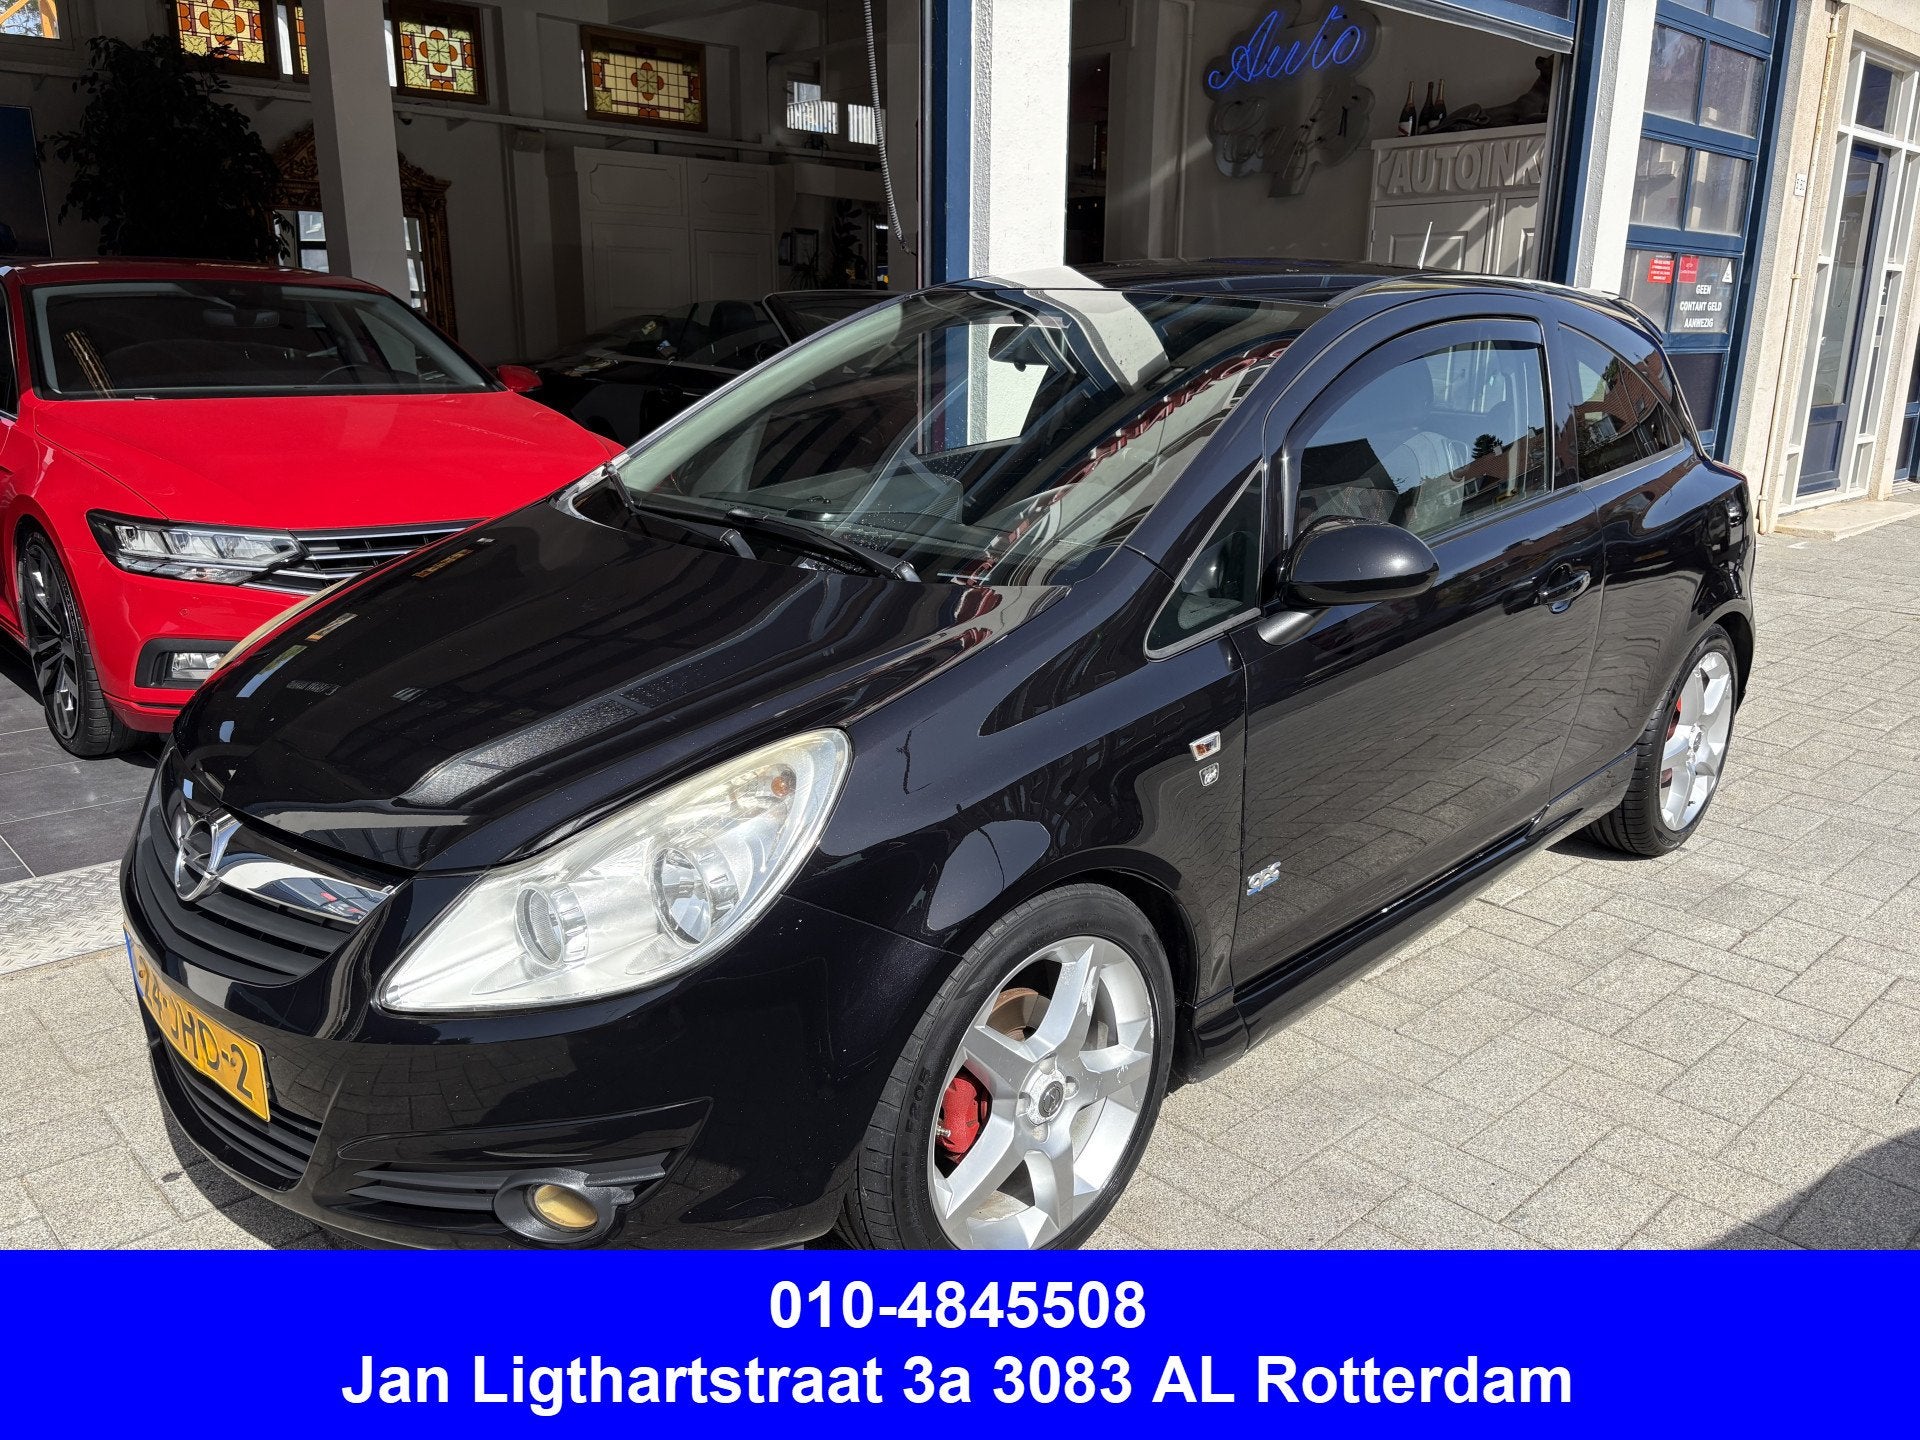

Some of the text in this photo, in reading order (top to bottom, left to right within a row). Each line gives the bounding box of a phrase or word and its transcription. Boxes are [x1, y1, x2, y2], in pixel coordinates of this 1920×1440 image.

[1208, 5, 1361, 90] Auto
[1695, 284, 1712, 295] GEEN
[1679, 301, 1722, 312] CONTANT GELD
[1683, 317, 1714, 329] AANWEZIG
